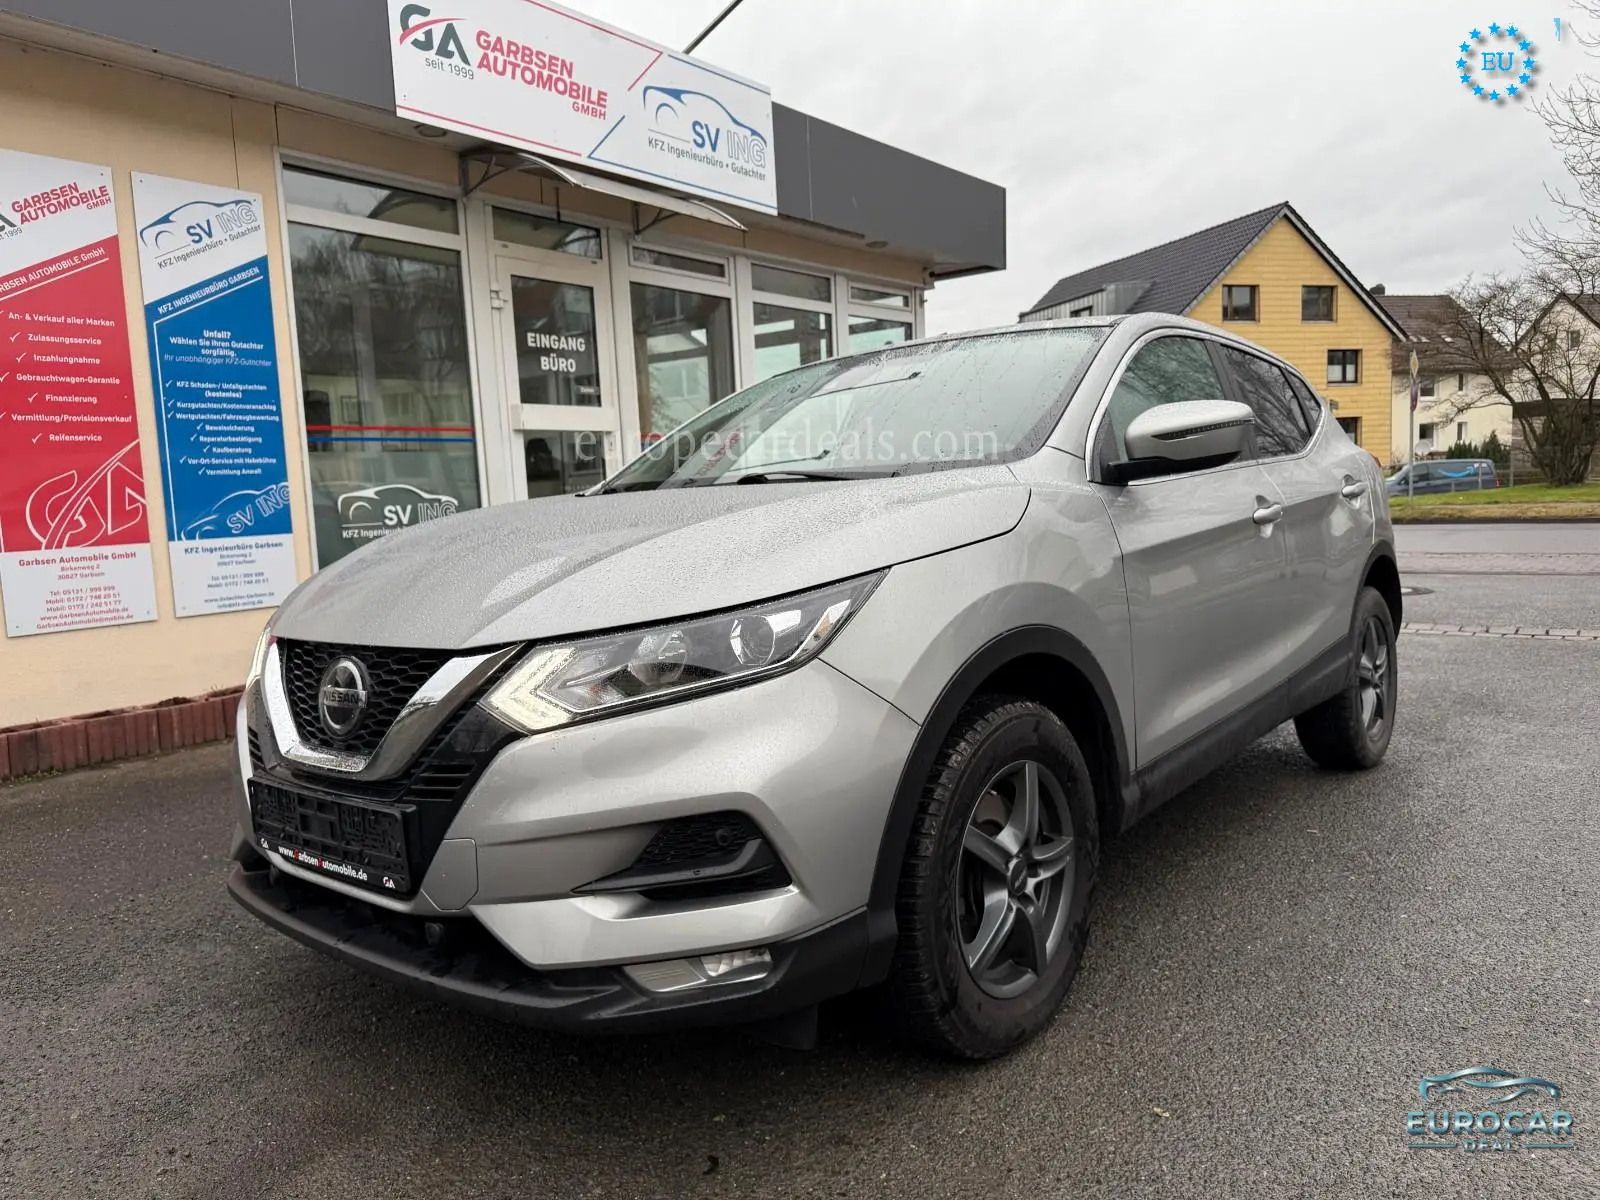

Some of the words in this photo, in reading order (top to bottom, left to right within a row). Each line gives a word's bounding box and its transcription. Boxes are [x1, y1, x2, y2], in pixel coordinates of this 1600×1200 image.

[475, 30, 574, 79] GARBSEN
[425, 57, 444, 71] seit
[448, 63, 474, 80] 1999
[477, 52, 608, 109] AUTOMOBILE
[572, 101, 607, 120] GMBH
[692, 120, 720, 152] SV
[727, 130, 766, 168] ING
[648, 137, 665, 152] KFZ
[667, 143, 724, 169] Ingenieurbüro
[731, 163, 766, 181] Gutachter
[11, 182, 80, 213] GARBSEN
[20, 185, 109, 225] AUTOMOBILE
[86, 197, 112, 210] GMBH
[4, 226, 23, 238] 1999
[186, 219, 213, 243] SV
[216, 204, 257, 233] ING
[157, 256, 174, 270] KFZ
[175, 239, 223, 262] Ingenieurbüro
[229, 224, 261, 241] Gutachter
[0, 276, 27, 294] RBSEN
[28, 256, 81, 281] AUTOMOBILE
[81, 247, 105, 261] GmbH
[158, 302, 173, 315] KFZ
[173, 280, 228, 307] INGENIEURBÜRO
[228, 266, 260, 286] GARBSEN
[33, 314, 65, 323] Verkauf
[66, 316, 84, 325] aller
[86, 318, 115, 327] Marken
[27, 333, 102, 346] Zulassungsservice
[169, 336, 197, 346] Wählen
[211, 340, 230, 348] Ihren
[231, 341, 264, 350] Gutachter
[203, 329, 231, 339] Unfall?
[526, 332, 586, 352] EINGANG
[33, 354, 100, 365] Inzahlungnahme
[540, 353, 576, 373] BÜRO
[16, 373, 120, 385] Gebrauchtwagen-Garantie
[45, 394, 98, 404] Finanzierung
[49, 433, 102, 442] Reifenservice
[226, 504, 254, 534] SV
[256, 482, 289, 518] ING
[383, 504, 412, 525] SV
[342, 529, 359, 538] KFZ
[184, 547, 200, 555] KFZ
[201, 541, 253, 553] Ingenieurbüro
[254, 541, 283, 549] Garbsen
[18, 556, 57, 567] Garbsen
[59, 553, 109, 564] Automobile
[111, 551, 136, 560] GmbH
